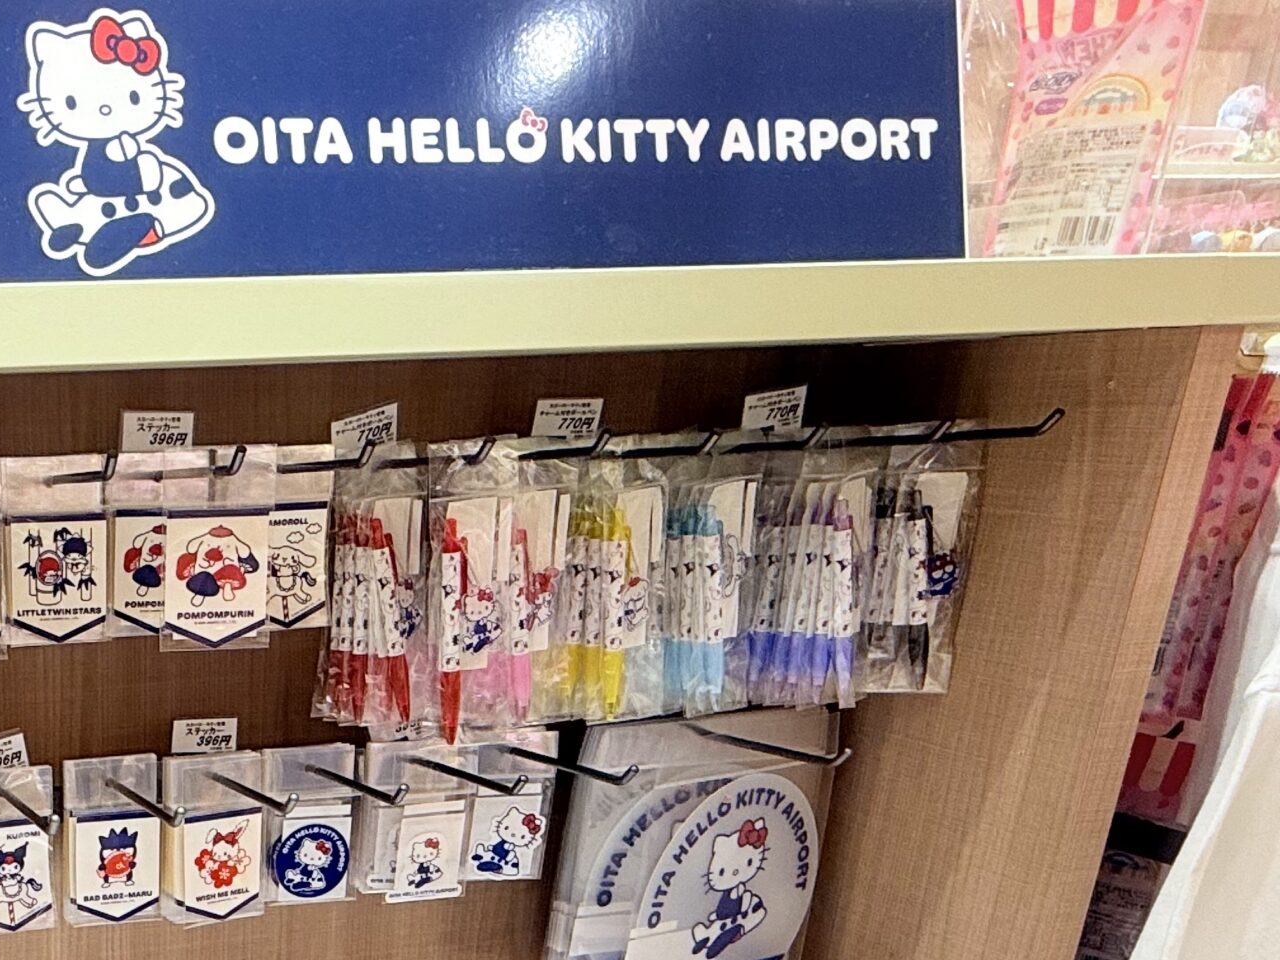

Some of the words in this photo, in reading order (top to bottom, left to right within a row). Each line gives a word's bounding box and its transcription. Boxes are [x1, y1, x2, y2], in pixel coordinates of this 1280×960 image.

[215, 116, 353, 165] OITA
[370, 113, 545, 164] HELLO
[561, 117, 709, 163] KITTY
[721, 117, 939, 163] AIRPORT
[766, 403, 800, 421] 770円
[137, 423, 180, 432] ステッカー
[558, 417, 595, 430] 770円
[357, 421, 393, 442] 770円
[150, 433, 188, 445] 396円
[177, 609, 255, 620] POMPOMPURIN
[186, 727, 225, 736] ステッカー
[196, 735, 232, 746] 396円
[7, 830, 41, 841] KUROMI
[597, 850, 628, 907] OITA
[622, 790, 692, 848] HELLO
[647, 871, 676, 928] OITA
[673, 801, 732, 865] HELLO
[736, 787, 786, 811] KITTY
[781, 802, 810, 891] AIRPORT
[83, 894, 101, 902] BAD
[195, 892, 216, 902] WISH
[218, 890, 229, 900] ME
[231, 888, 250, 898] MELL
